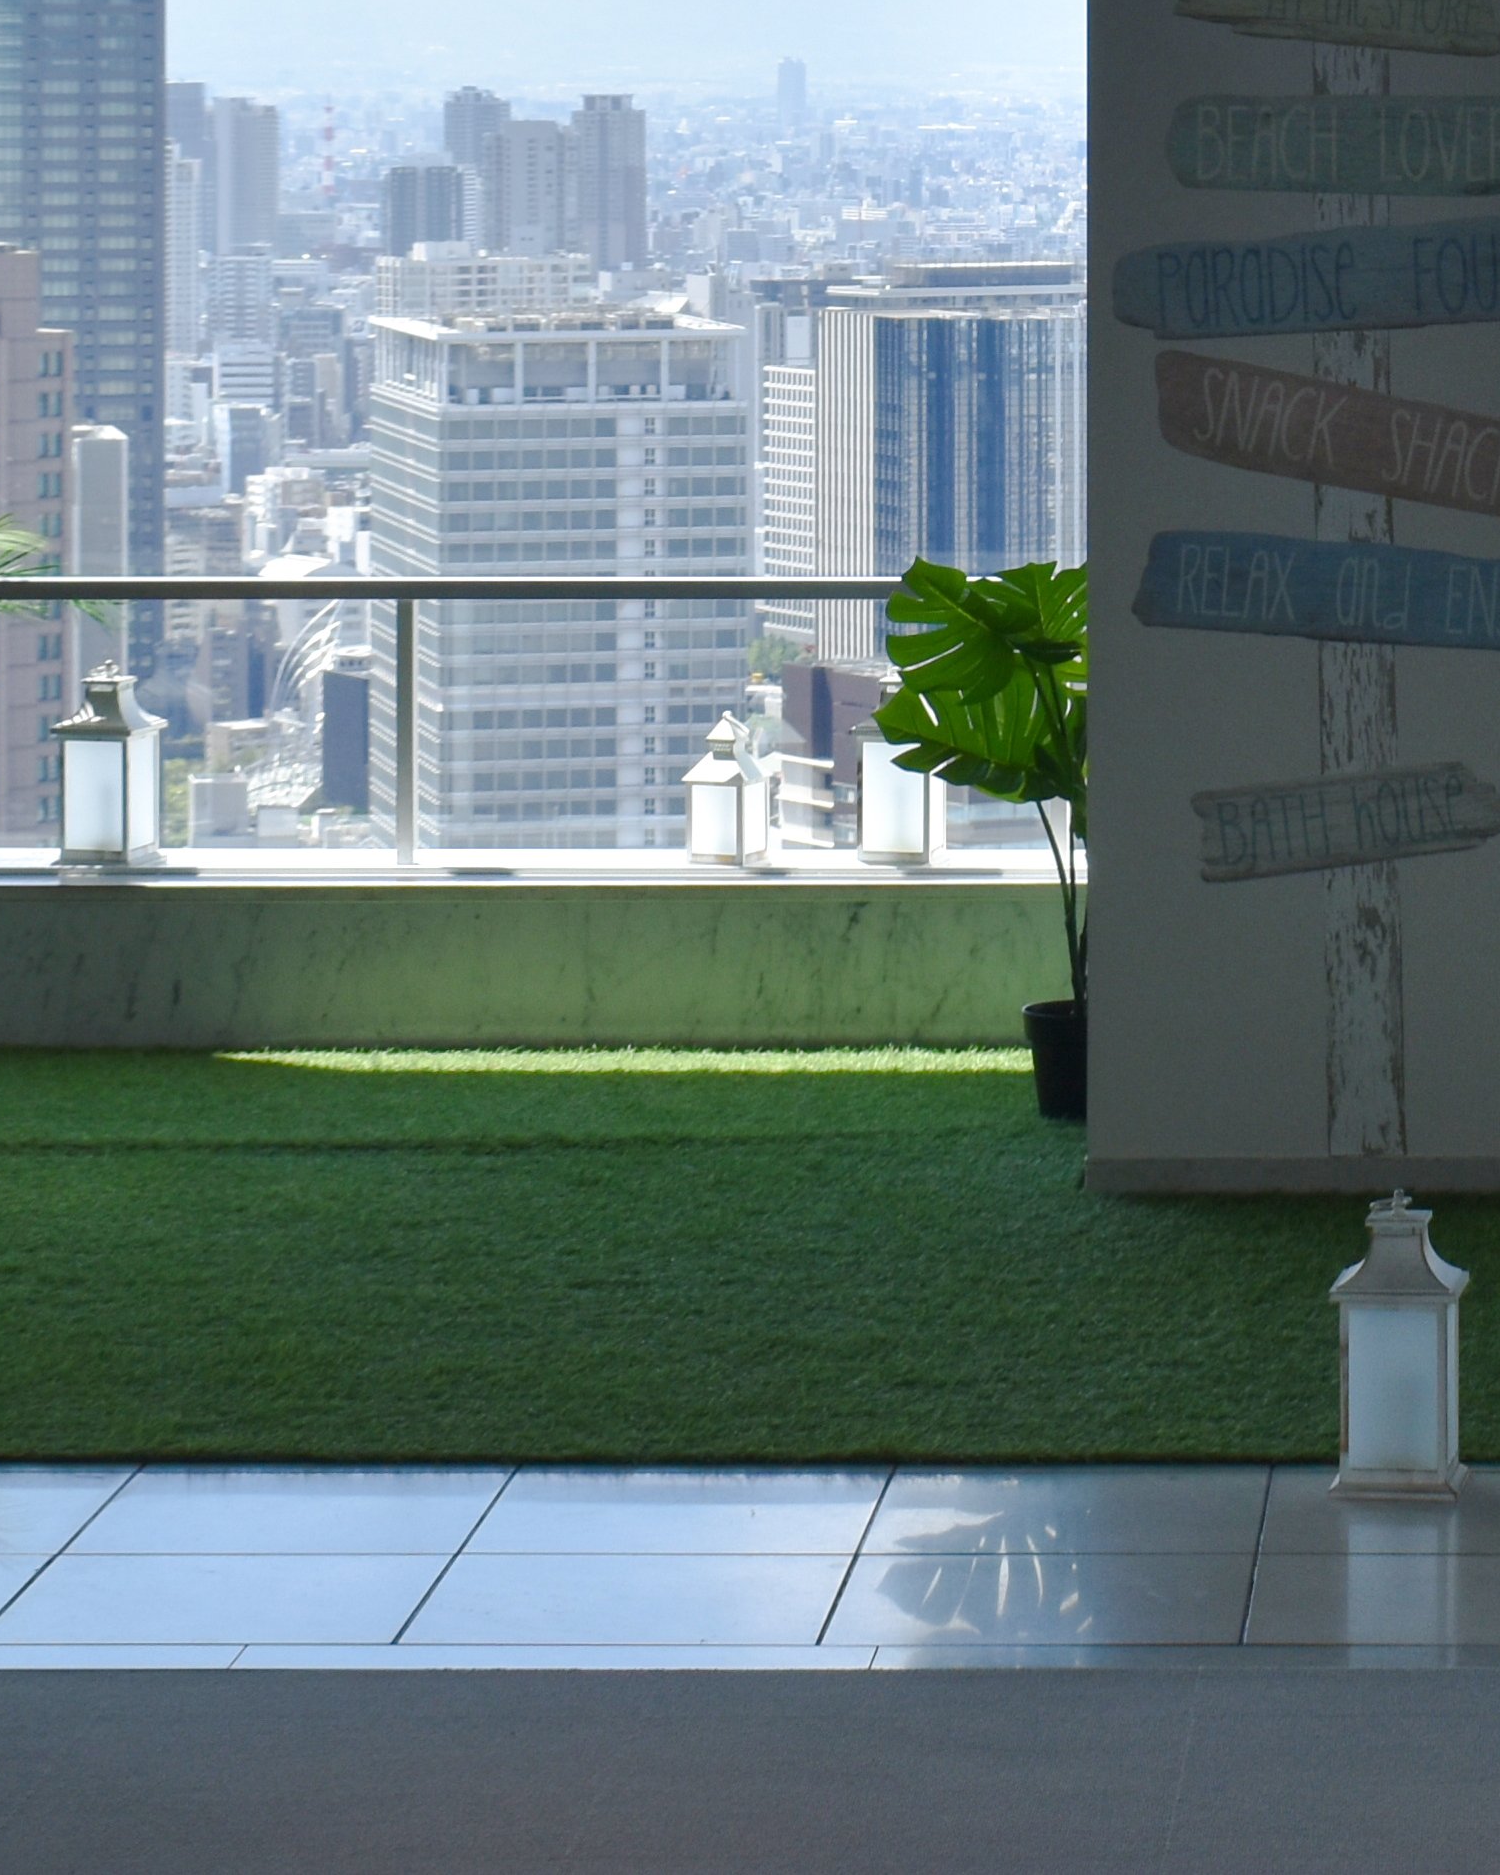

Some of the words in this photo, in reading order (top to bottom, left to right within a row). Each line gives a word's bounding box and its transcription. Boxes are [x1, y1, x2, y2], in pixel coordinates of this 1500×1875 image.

[1195, 103, 1339, 182] BEACH
[1193, 365, 1349, 470] SNACK
[1176, 542, 1296, 623] RELAX
[1215, 789, 1331, 867] BATH
